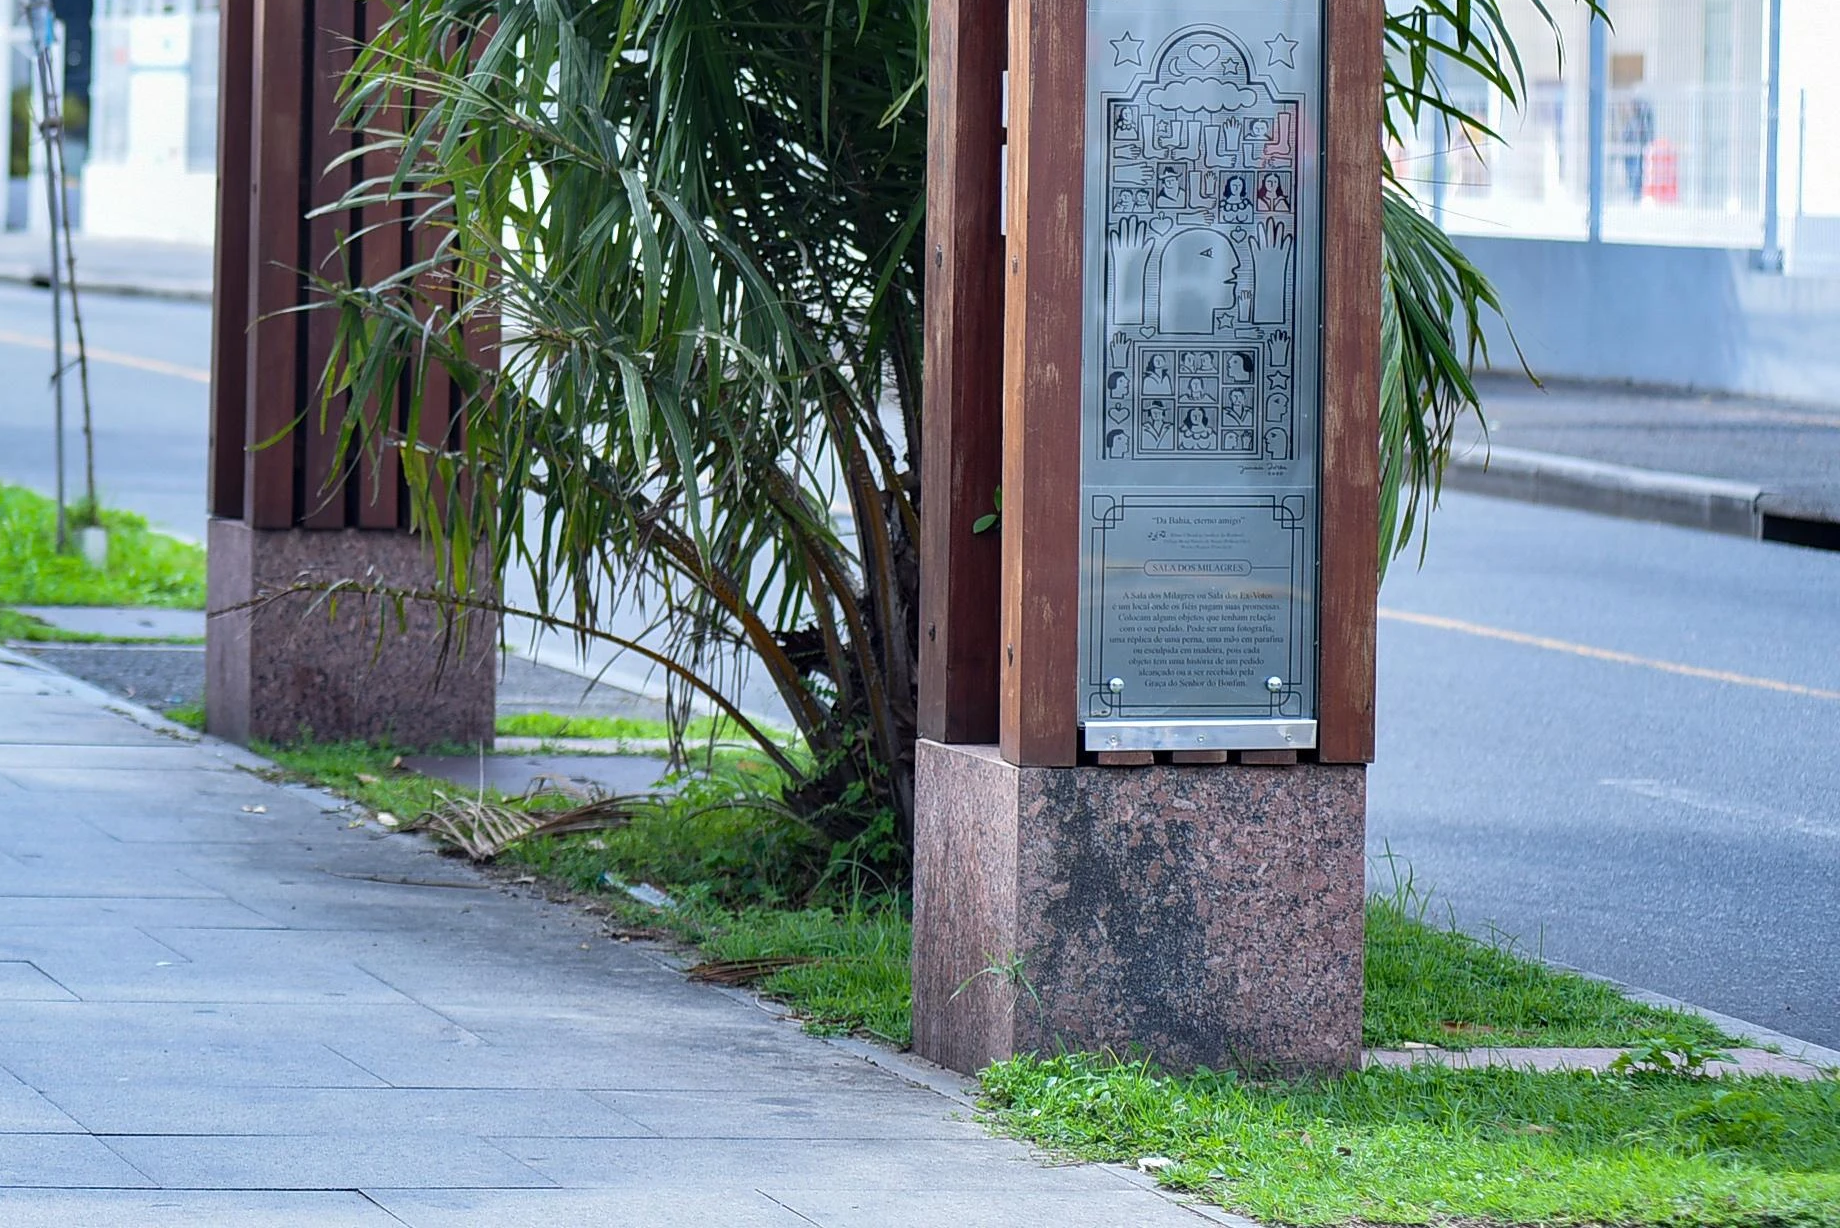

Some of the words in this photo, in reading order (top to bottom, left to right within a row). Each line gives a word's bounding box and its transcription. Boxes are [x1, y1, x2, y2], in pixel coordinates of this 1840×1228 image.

[1153, 564, 1176, 572] SALA
[1178, 564, 1196, 572] DOS
[1198, 564, 1244, 572] MILAGRES
[1163, 592, 1195, 601] Milagres
[1199, 604, 1223, 612] pagam
[1153, 614, 1177, 623] alguns
[1178, 614, 1204, 623] objetos
[1207, 615, 1220, 623] que
[1250, 614, 1276, 623] relação
[1128, 636, 1152, 645] réplica
[1254, 636, 1284, 645] parafina
[1144, 647, 1179, 656] esculpida
[1193, 647, 1224, 656] madeira,
[1226, 647, 1242, 656] pois
[1129, 658, 1152, 667] objeto
[1240, 658, 1264, 667] pedido
[1139, 669, 1175, 678] alcançado
[1239, 669, 1255, 678] pela
[1145, 680, 1166, 689] Graça
